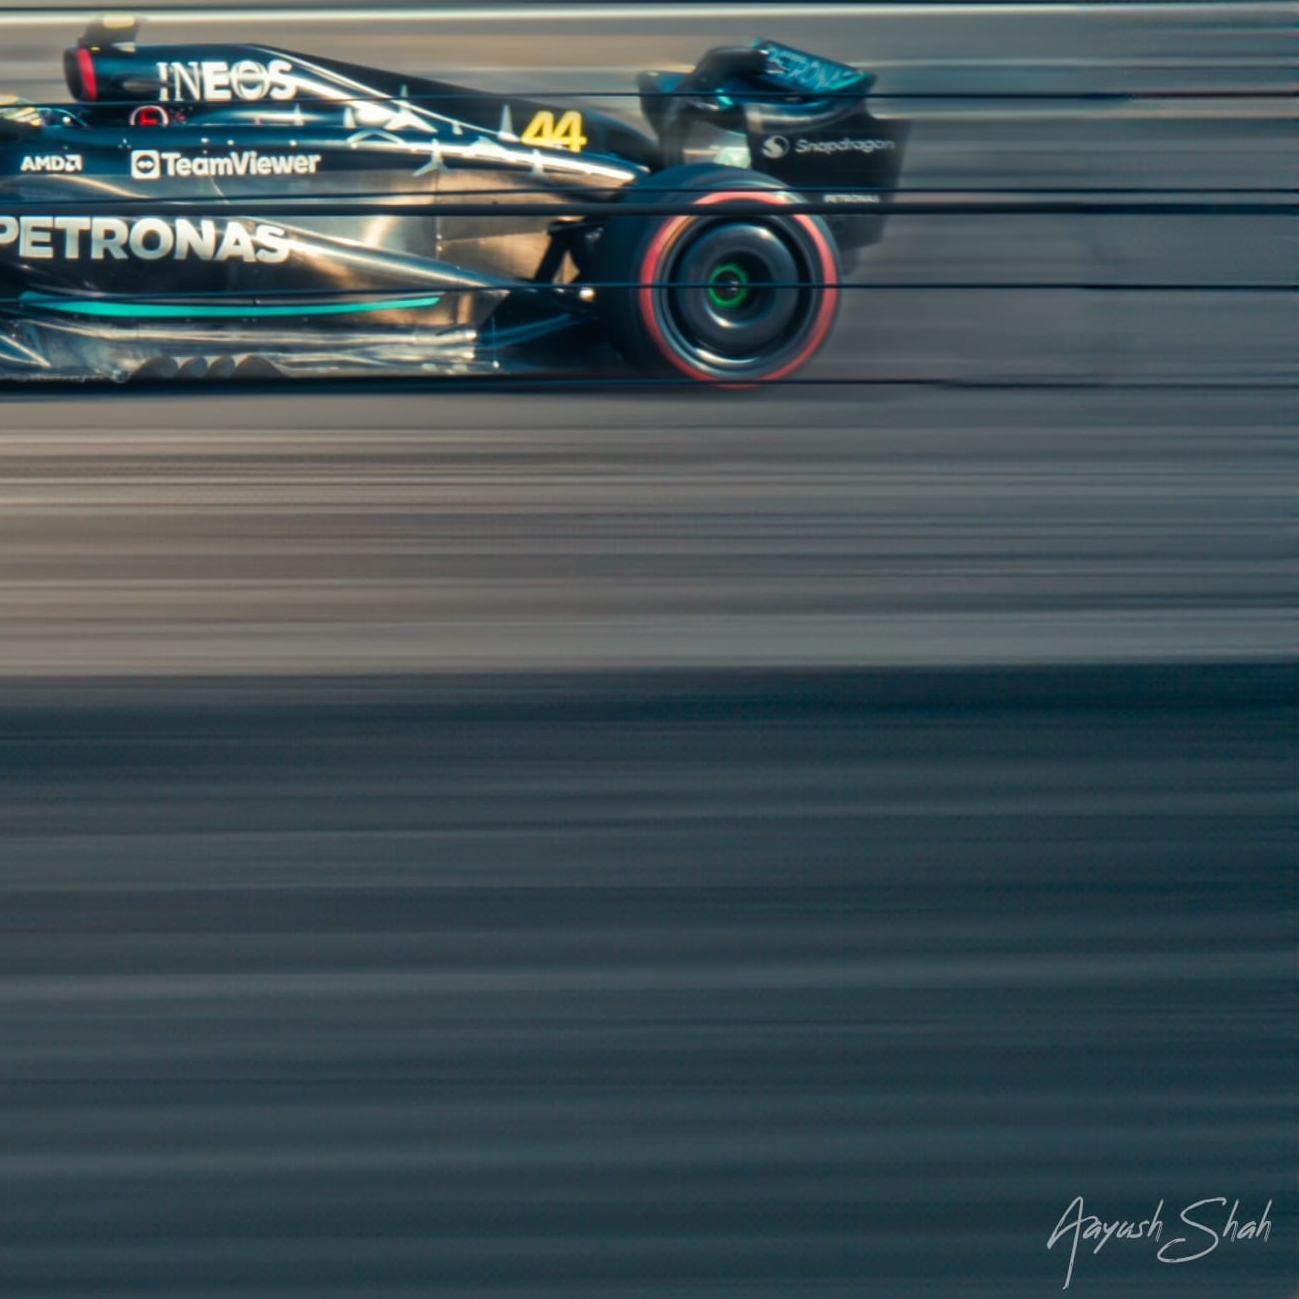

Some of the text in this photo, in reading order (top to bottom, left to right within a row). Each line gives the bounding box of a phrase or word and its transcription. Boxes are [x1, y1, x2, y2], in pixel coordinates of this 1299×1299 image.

[156, 60, 298, 102] INEOS
[521, 110, 587, 153] 44
[795, 138, 895, 155] Snapdragon
[20, 155, 63, 172] AMD
[161, 151, 322, 176] TeamViewer
